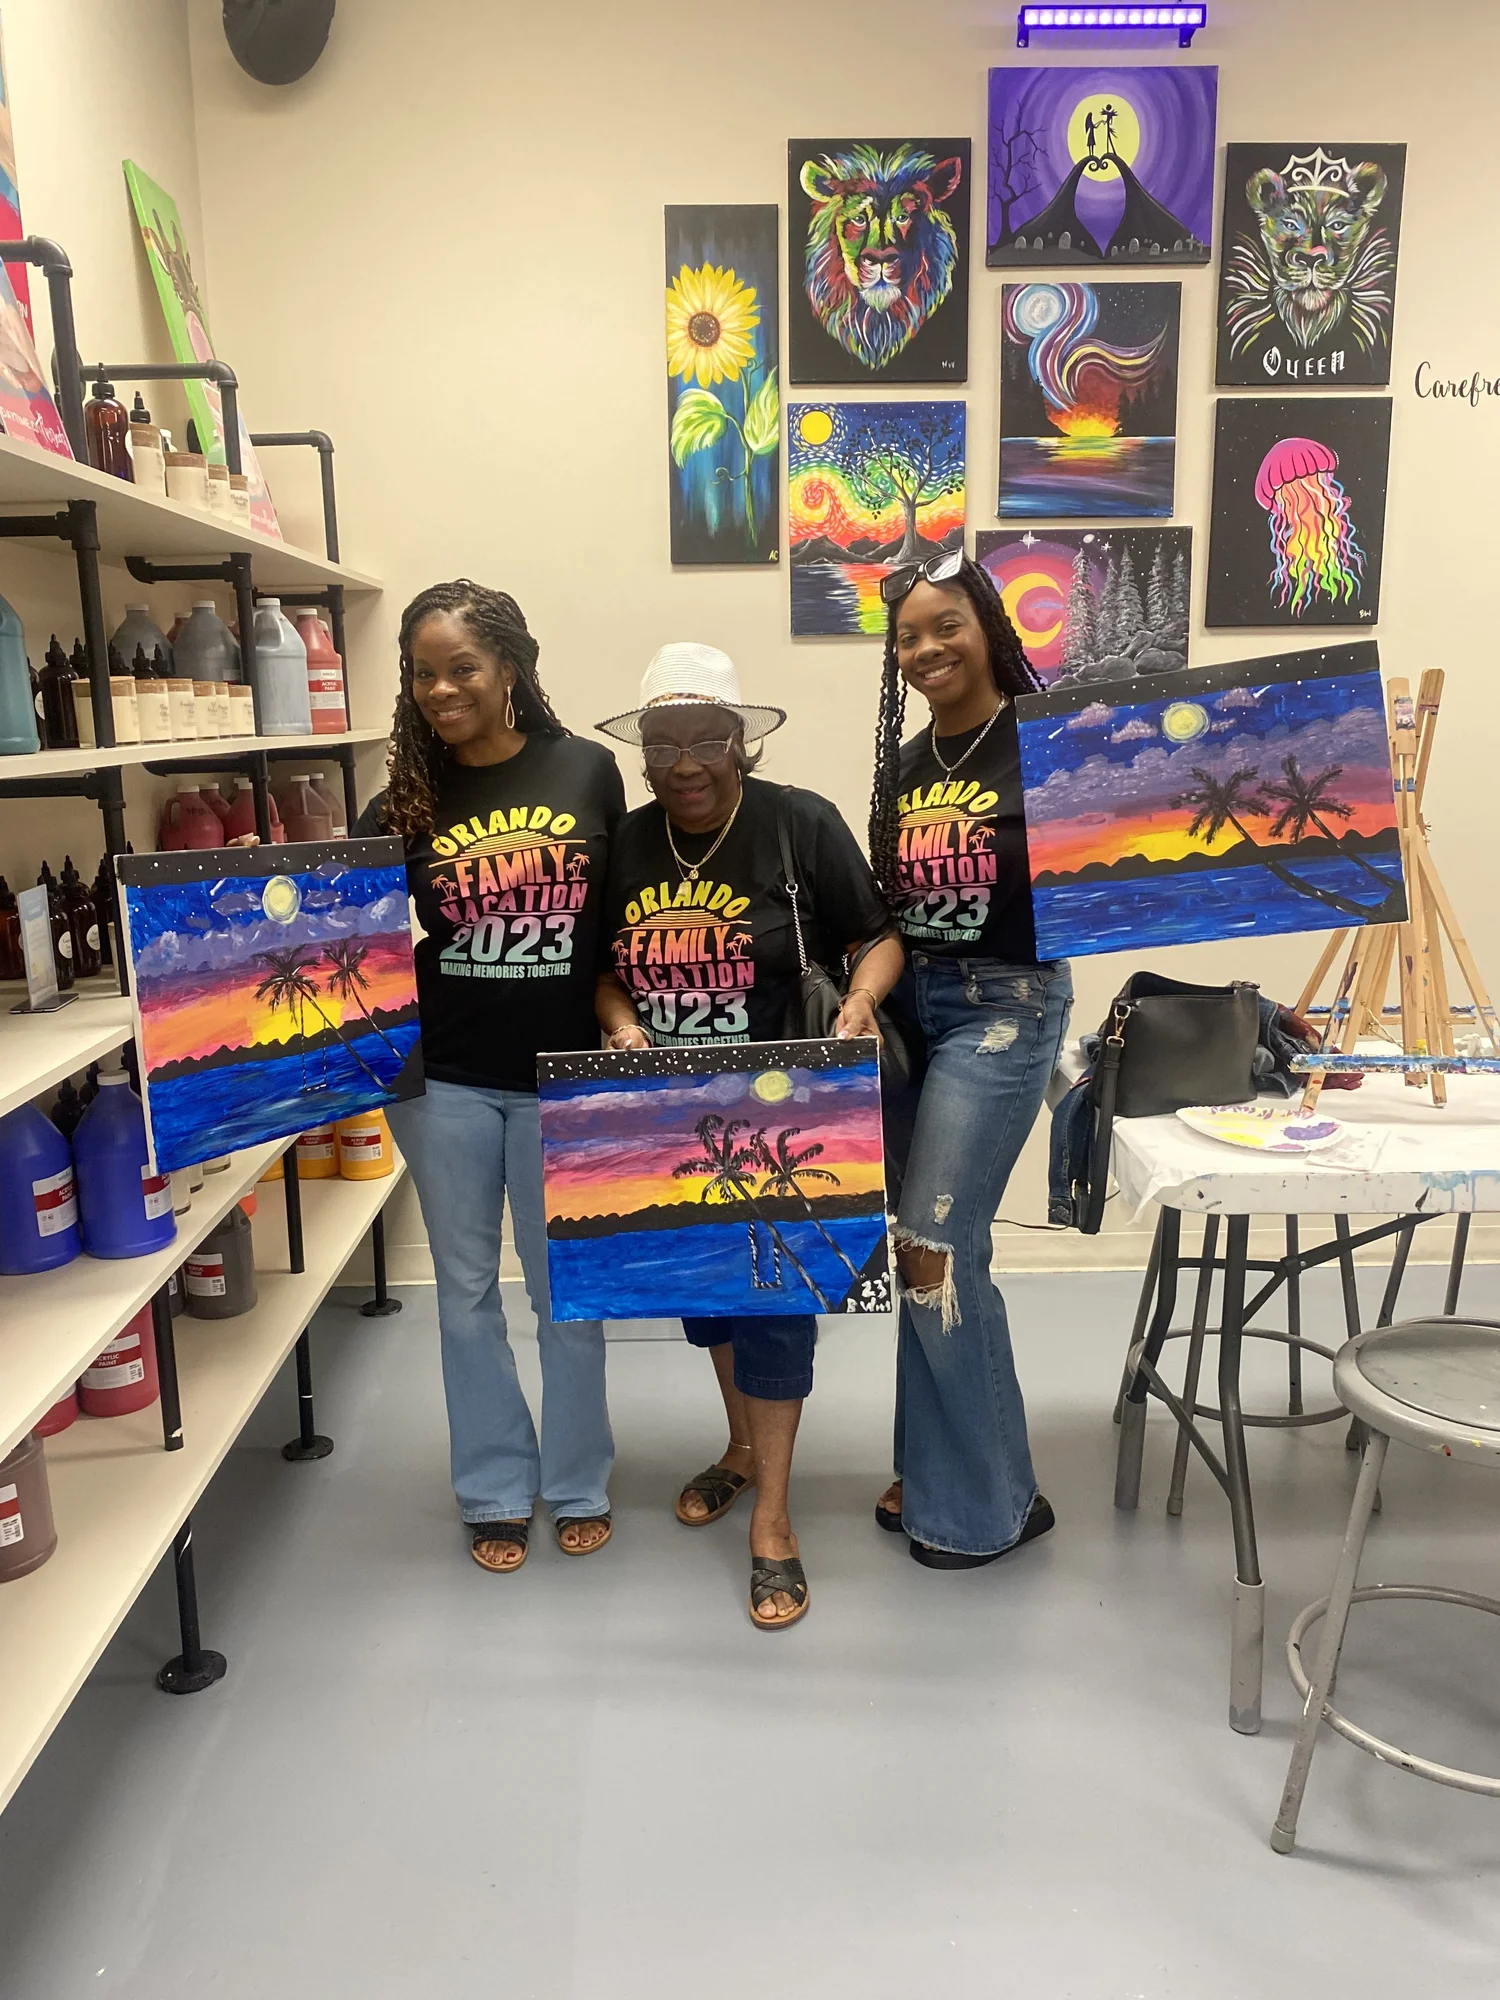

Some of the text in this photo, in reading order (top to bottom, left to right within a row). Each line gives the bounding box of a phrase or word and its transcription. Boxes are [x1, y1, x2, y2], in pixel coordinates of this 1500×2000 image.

[897, 780, 999, 815] RLANDO
[431, 805, 577, 857] ORLANDO
[898, 820, 976, 863] AMILY
[455, 844, 567, 898] FAMILY
[896, 853, 998, 890] CATION
[439, 882, 589, 924] VACATION
[625, 880, 751, 925] ORLANDO
[900, 886, 991, 930] 023
[439, 914, 576, 963] 2023
[629, 925, 731, 966] FAMILY
[440, 961, 571, 979] MAKING MEMORIES TOGETHER
[615, 961, 755, 991] VACATION
